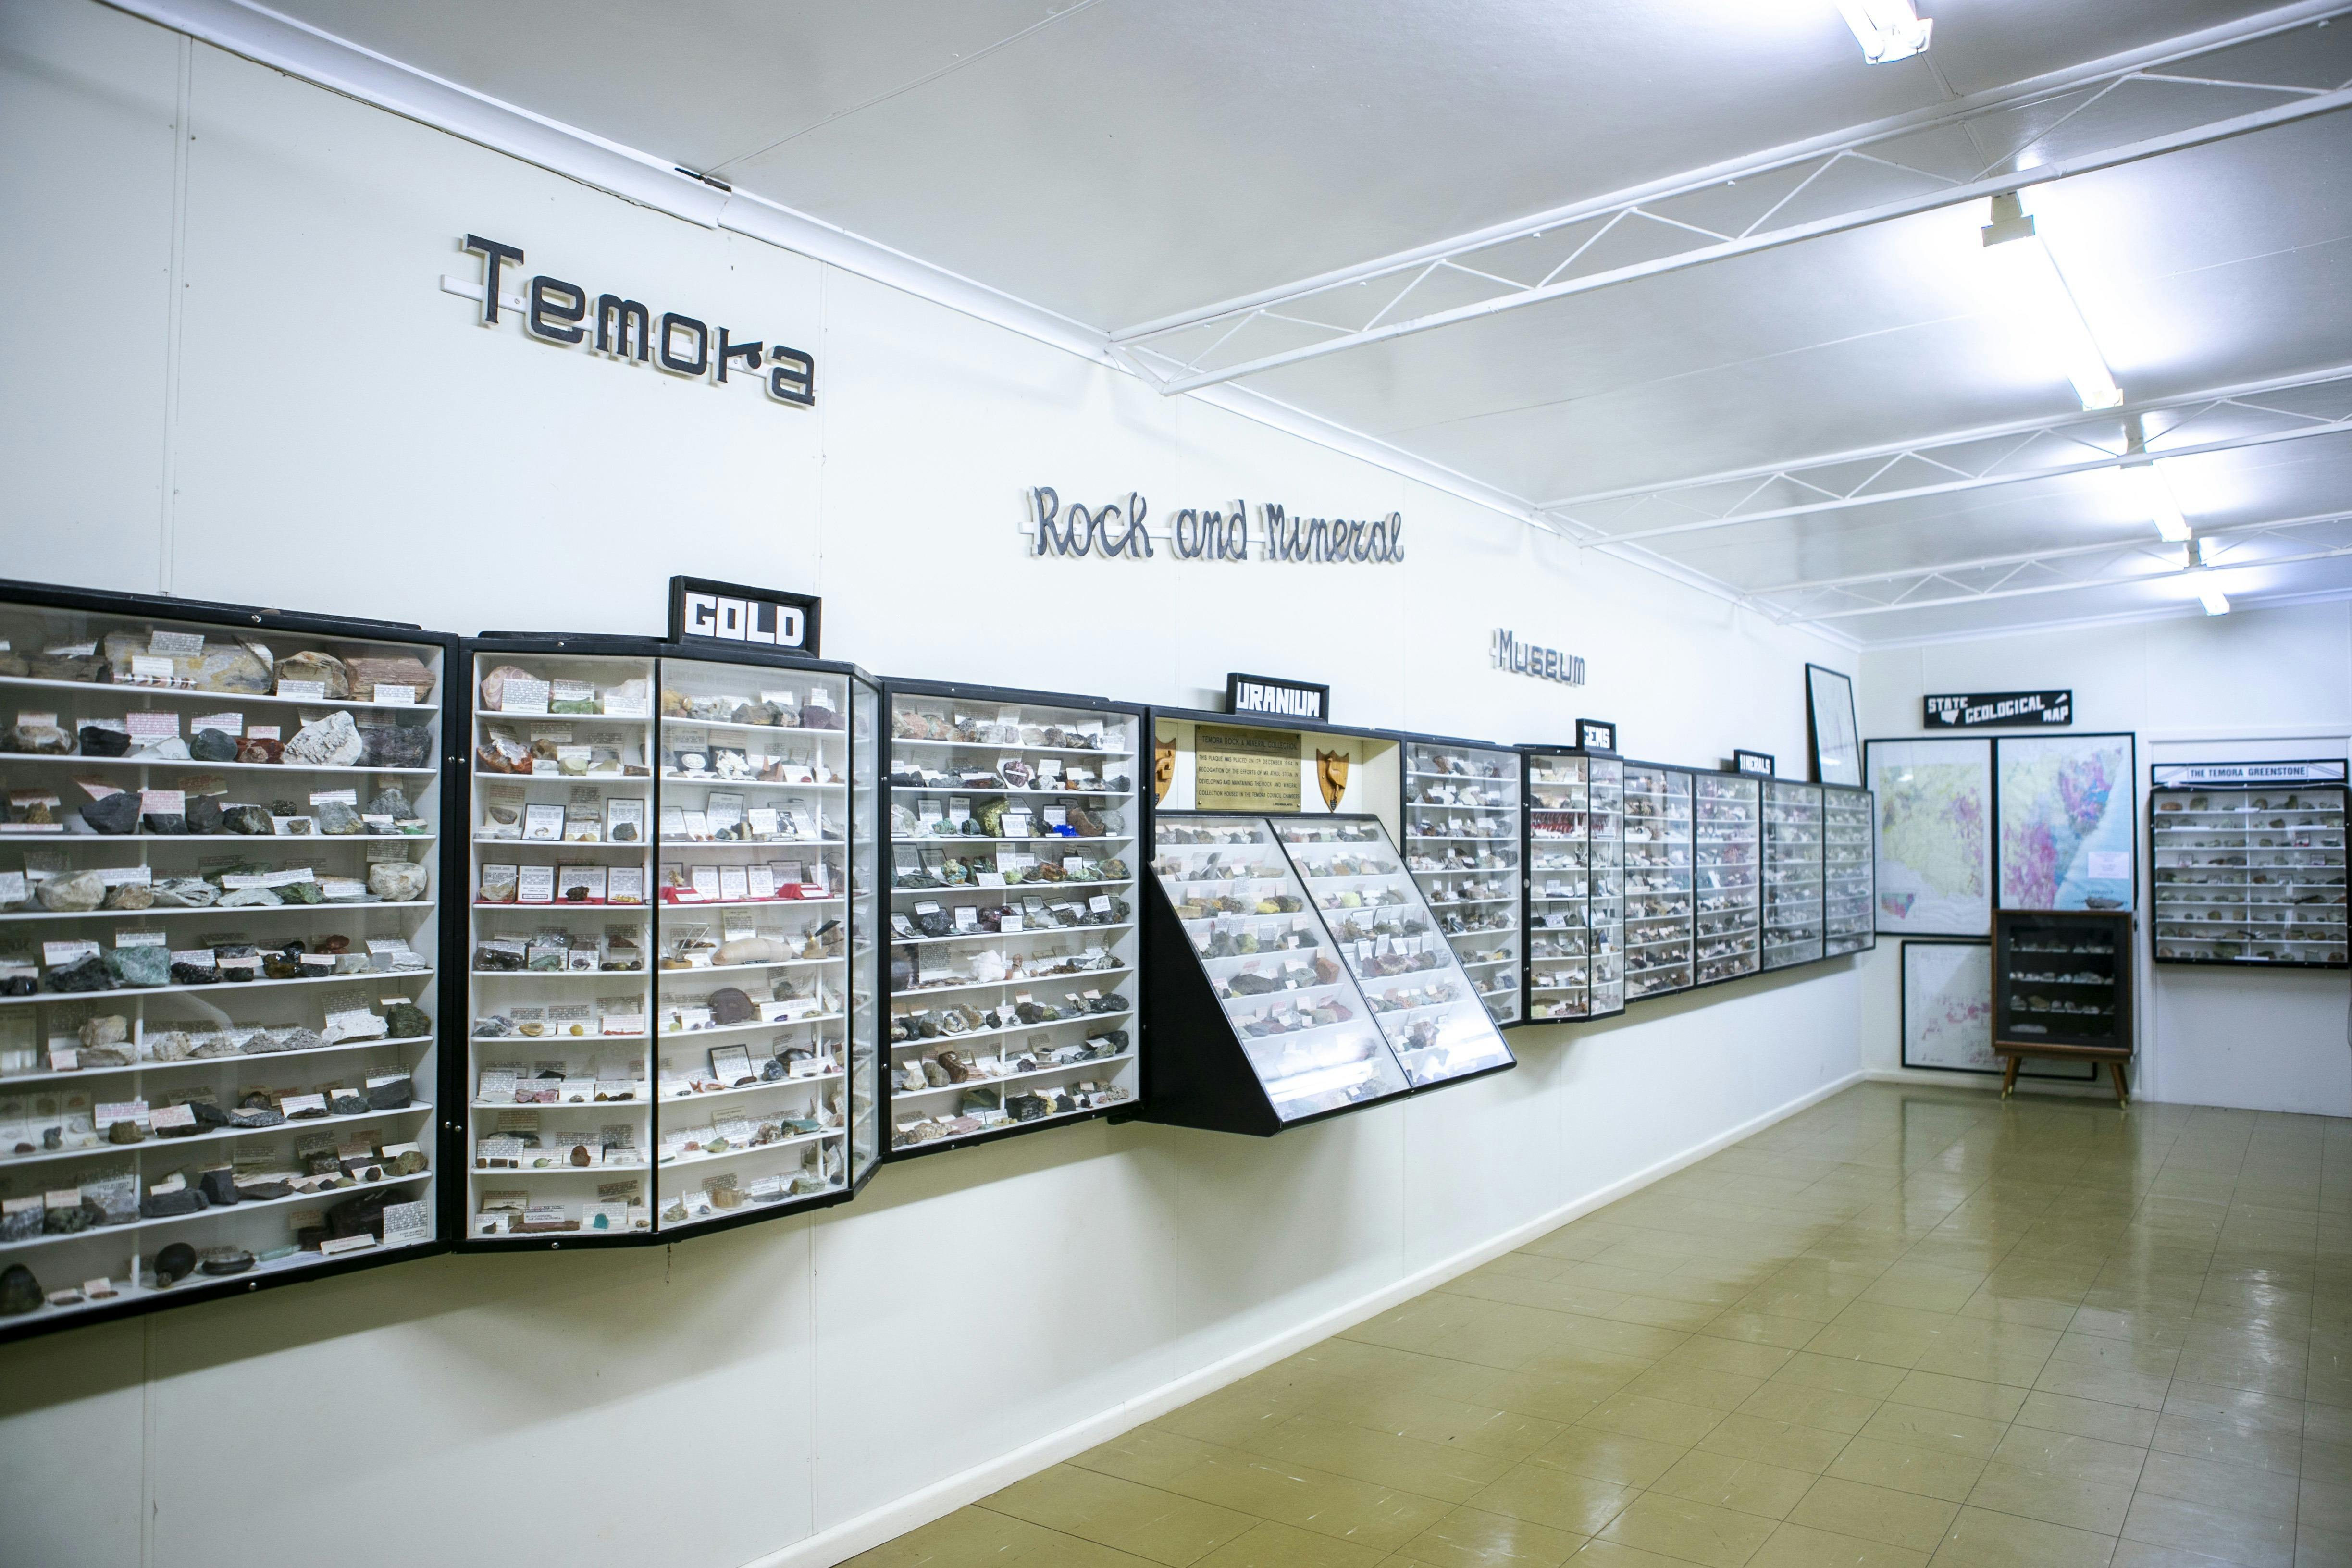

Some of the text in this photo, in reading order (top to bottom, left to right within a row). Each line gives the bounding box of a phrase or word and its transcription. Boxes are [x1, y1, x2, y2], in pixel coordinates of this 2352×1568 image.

[1030, 485, 1405, 563] Rock and Mineral
[685, 592, 804, 647] GOLD
[1494, 628, 1585, 686] Museum
[1237, 682, 1320, 717] URANIUM
[1928, 697, 1968, 713] STATE
[1965, 695, 2045, 724] GEOLOGICAL
[2042, 705, 2069, 722] MAP
[1202, 736, 1223, 744] TEMORA
[2208, 768, 2243, 778] TEMORA
[2248, 767, 2306, 777] GREENSTONE
